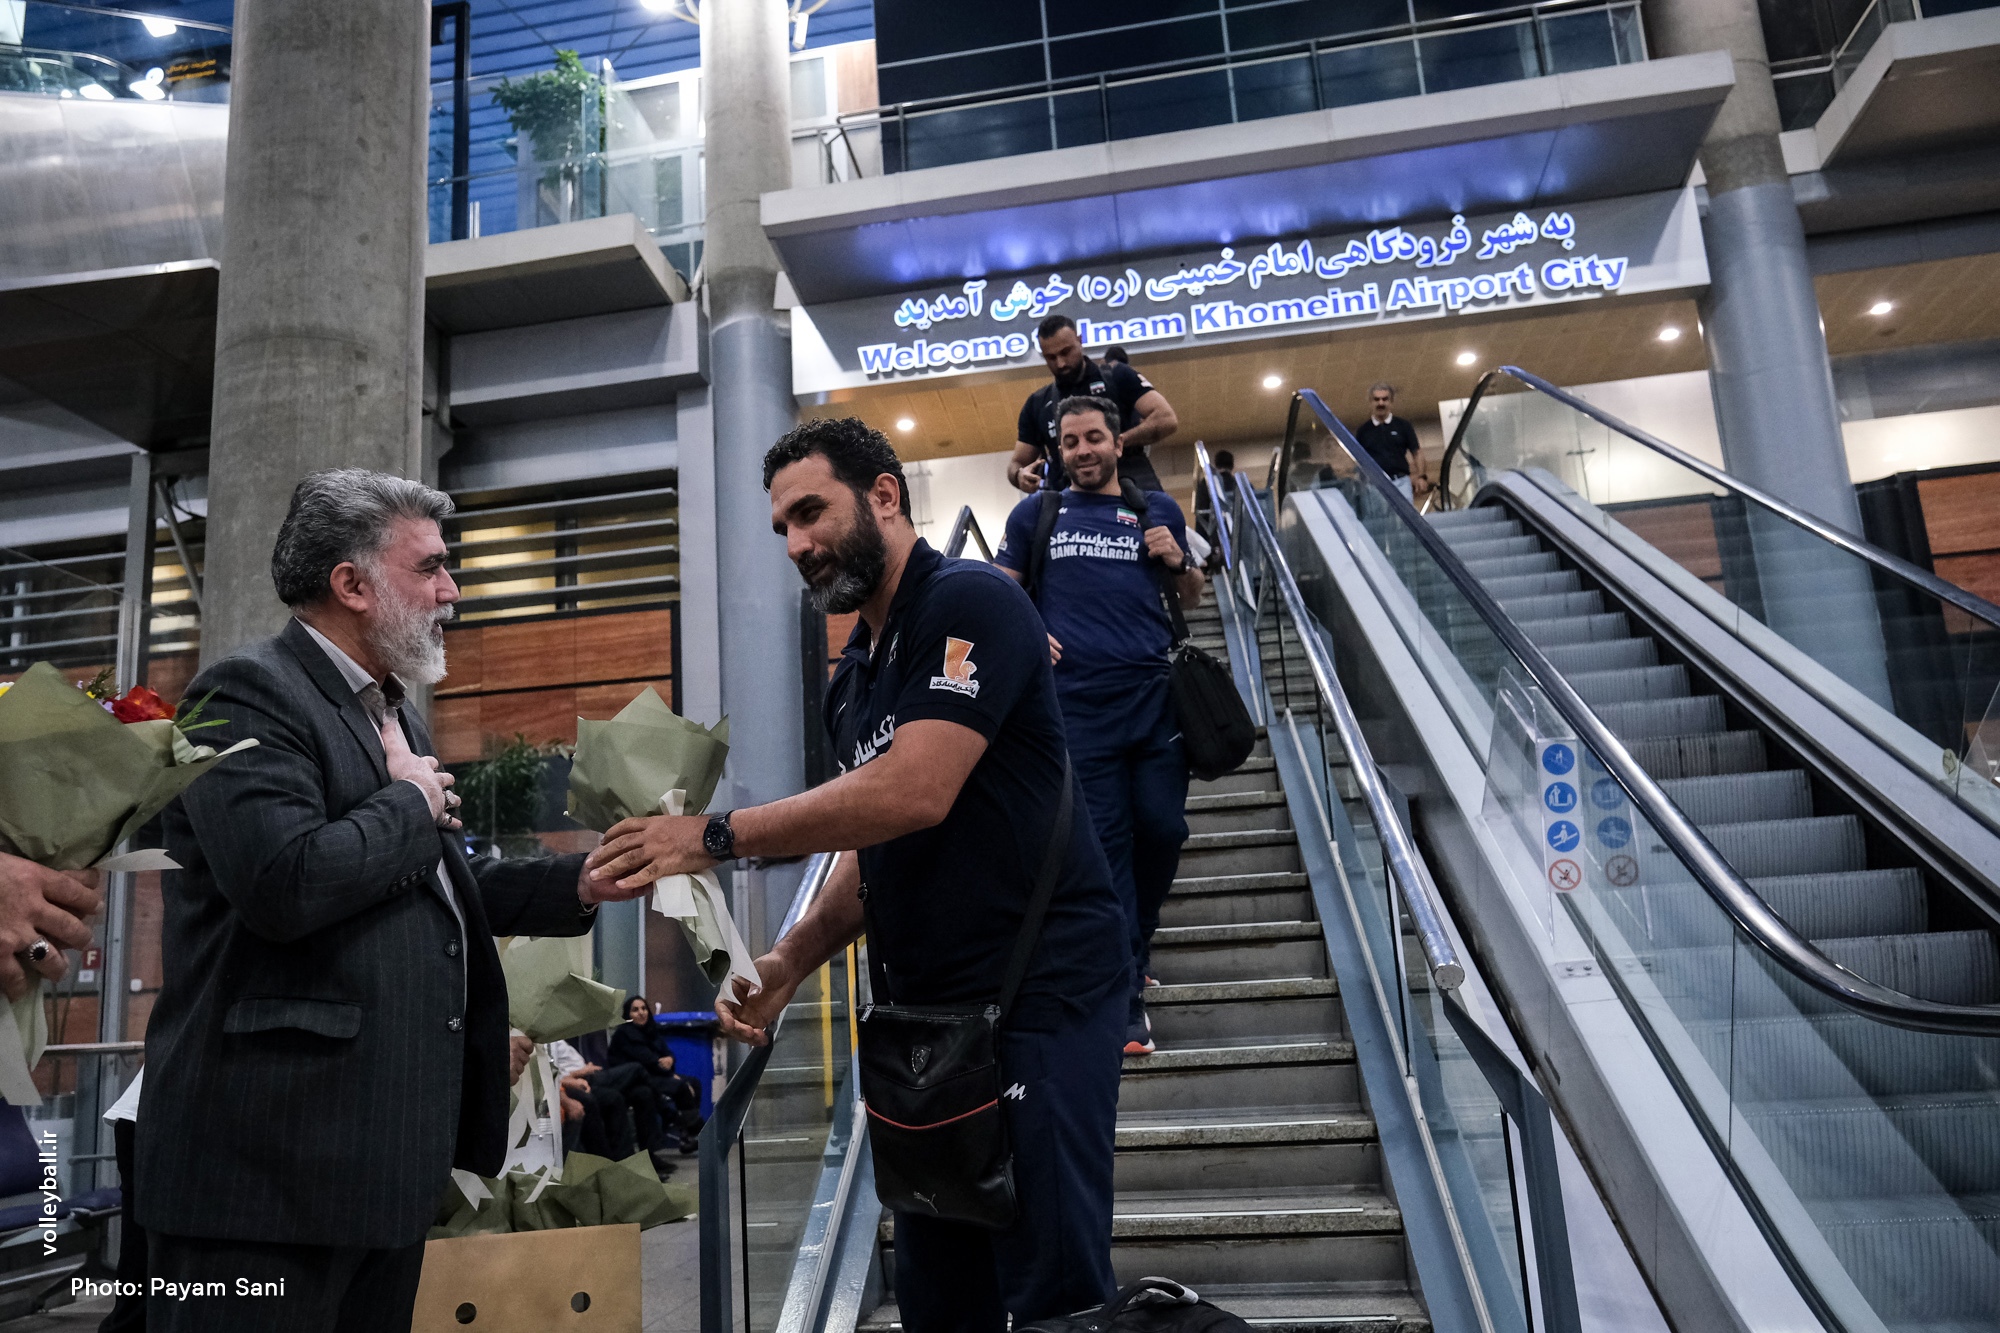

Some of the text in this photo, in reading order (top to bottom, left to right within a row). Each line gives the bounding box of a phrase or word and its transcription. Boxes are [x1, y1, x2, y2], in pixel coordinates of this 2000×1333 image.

[1315, 214, 1472, 279] فرودگاهی
[1476, 211, 1538, 259] شهر
[1540, 211, 1575, 250] به
[1248, 239, 1314, 289] امام
[857, 333, 1030, 375] Welcome
[1077, 311, 1186, 348] Imam
[1190, 282, 1380, 334] Khomeini
[1386, 261, 1535, 309] Airport
[1540, 254, 1629, 290] City
[894, 278, 988, 330] آمدید
[990, 273, 1074, 322] خوش
[1049, 544, 1139, 561] BANK PASARGAD
[86, 950, 98, 966] F
